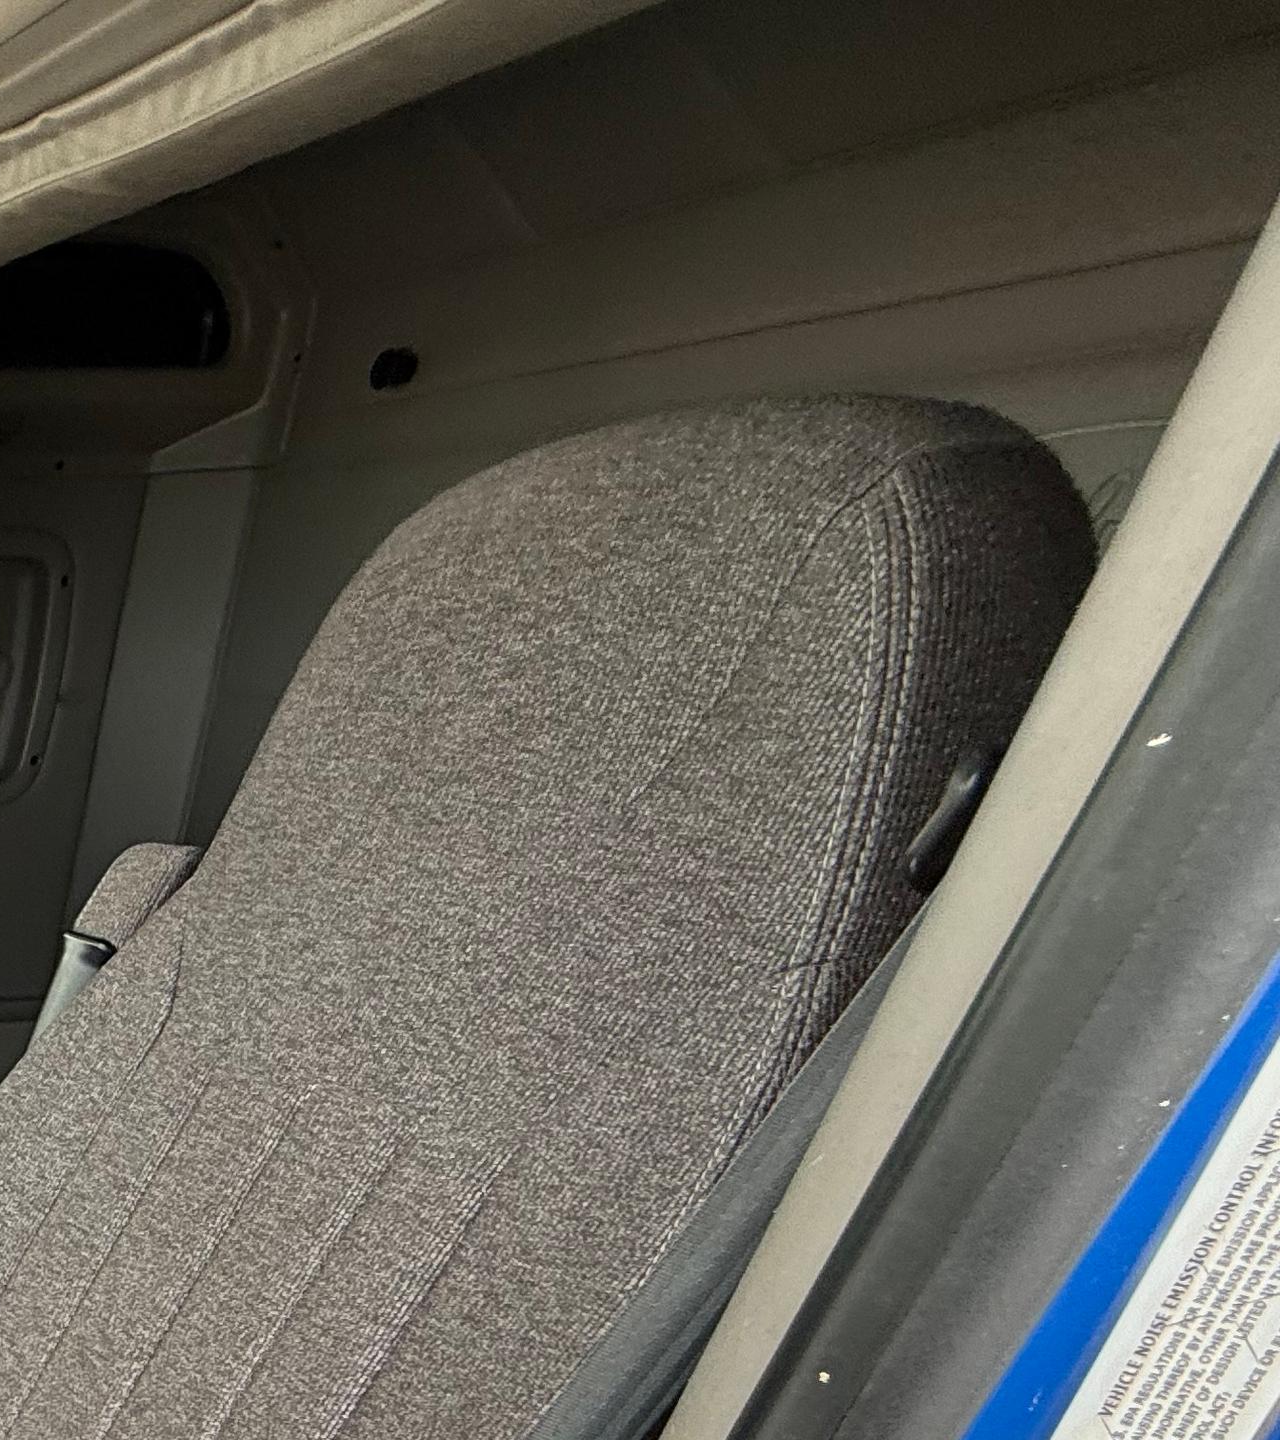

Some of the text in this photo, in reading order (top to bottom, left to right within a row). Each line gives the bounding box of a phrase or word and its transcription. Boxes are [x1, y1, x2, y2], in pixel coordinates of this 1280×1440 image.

[1097, 1107, 1280, 1416] VEHICLE NOISE EMISSION CONTROL INFO
[1119, 1406, 1141, 1427] EPA
[1132, 1330, 1187, 1406] REGULATIONS
[1178, 1306, 1201, 1329] FOR
[1192, 1268, 1224, 1305] NOISE
[1215, 1208, 1261, 1268] EMISSION
[1154, 1351, 1191, 1400] THEREOF
[1184, 1335, 1202, 1351] BY
[1196, 1310, 1217, 1335] ANY
[1210, 1264, 1247, 1311] PERSON
[1239, 1238, 1264, 1264] ARE
[1197, 1326, 1230, 1364] OTHER
[1220, 1293, 1250, 1324] THAN
[1241, 1268, 1266, 1293] FOR
[1256, 1243, 1280, 1266] THE
[1194, 1384, 1212, 1402] OF
[1204, 1341, 1241, 1385] DESIGN
[1233, 1297, 1267, 1342] LISTED
[1259, 1283, 1278, 1299] IN
[1230, 1366, 1267, 1410] DEVICE
[1258, 1348, 1279, 1367] OR
